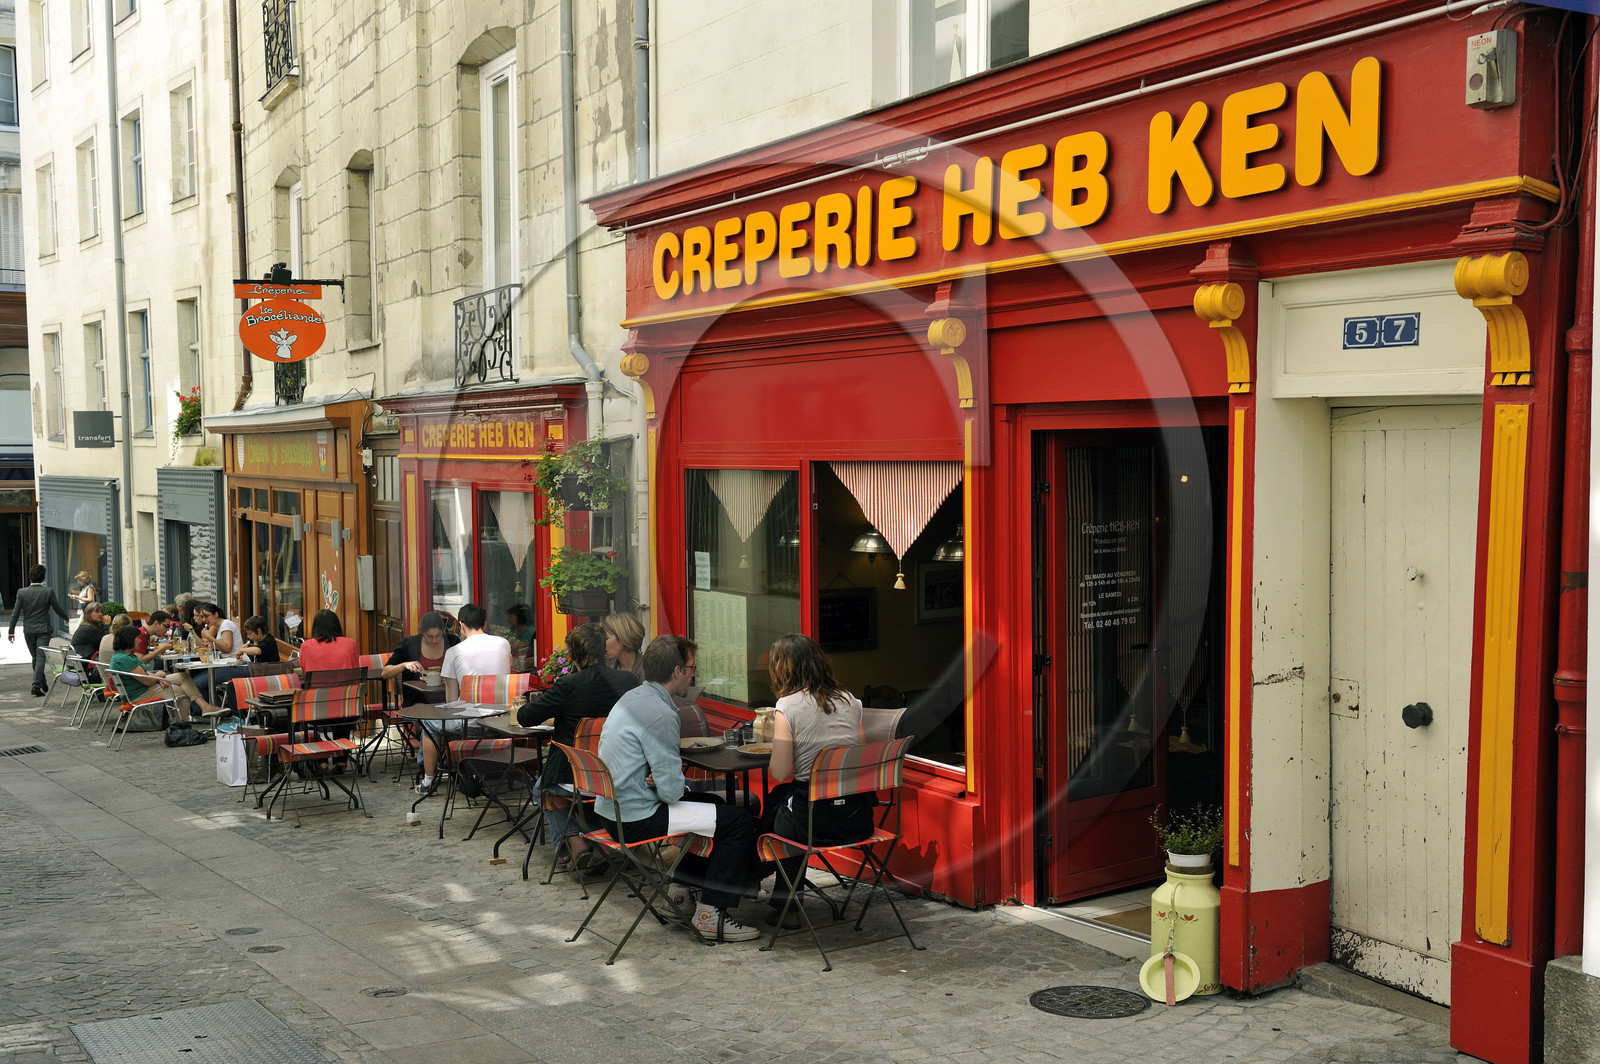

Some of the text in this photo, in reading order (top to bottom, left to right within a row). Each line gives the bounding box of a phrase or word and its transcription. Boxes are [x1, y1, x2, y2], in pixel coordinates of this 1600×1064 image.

[1471, 37, 1492, 47] NEON
[652, 56, 1381, 301] CREPERIE HEB KEN
[254, 284, 303, 298] Crêperie
[259, 305, 274, 315] Le
[245, 310, 322, 327] Brocéliande
[422, 421, 534, 448] CREPERIE HEB KEN
[1096, 620, 1104, 629] 02
[1104, 619, 1112, 627] 40
[1120, 617, 1129, 625] 79
[1129, 616, 1137, 624] 03
